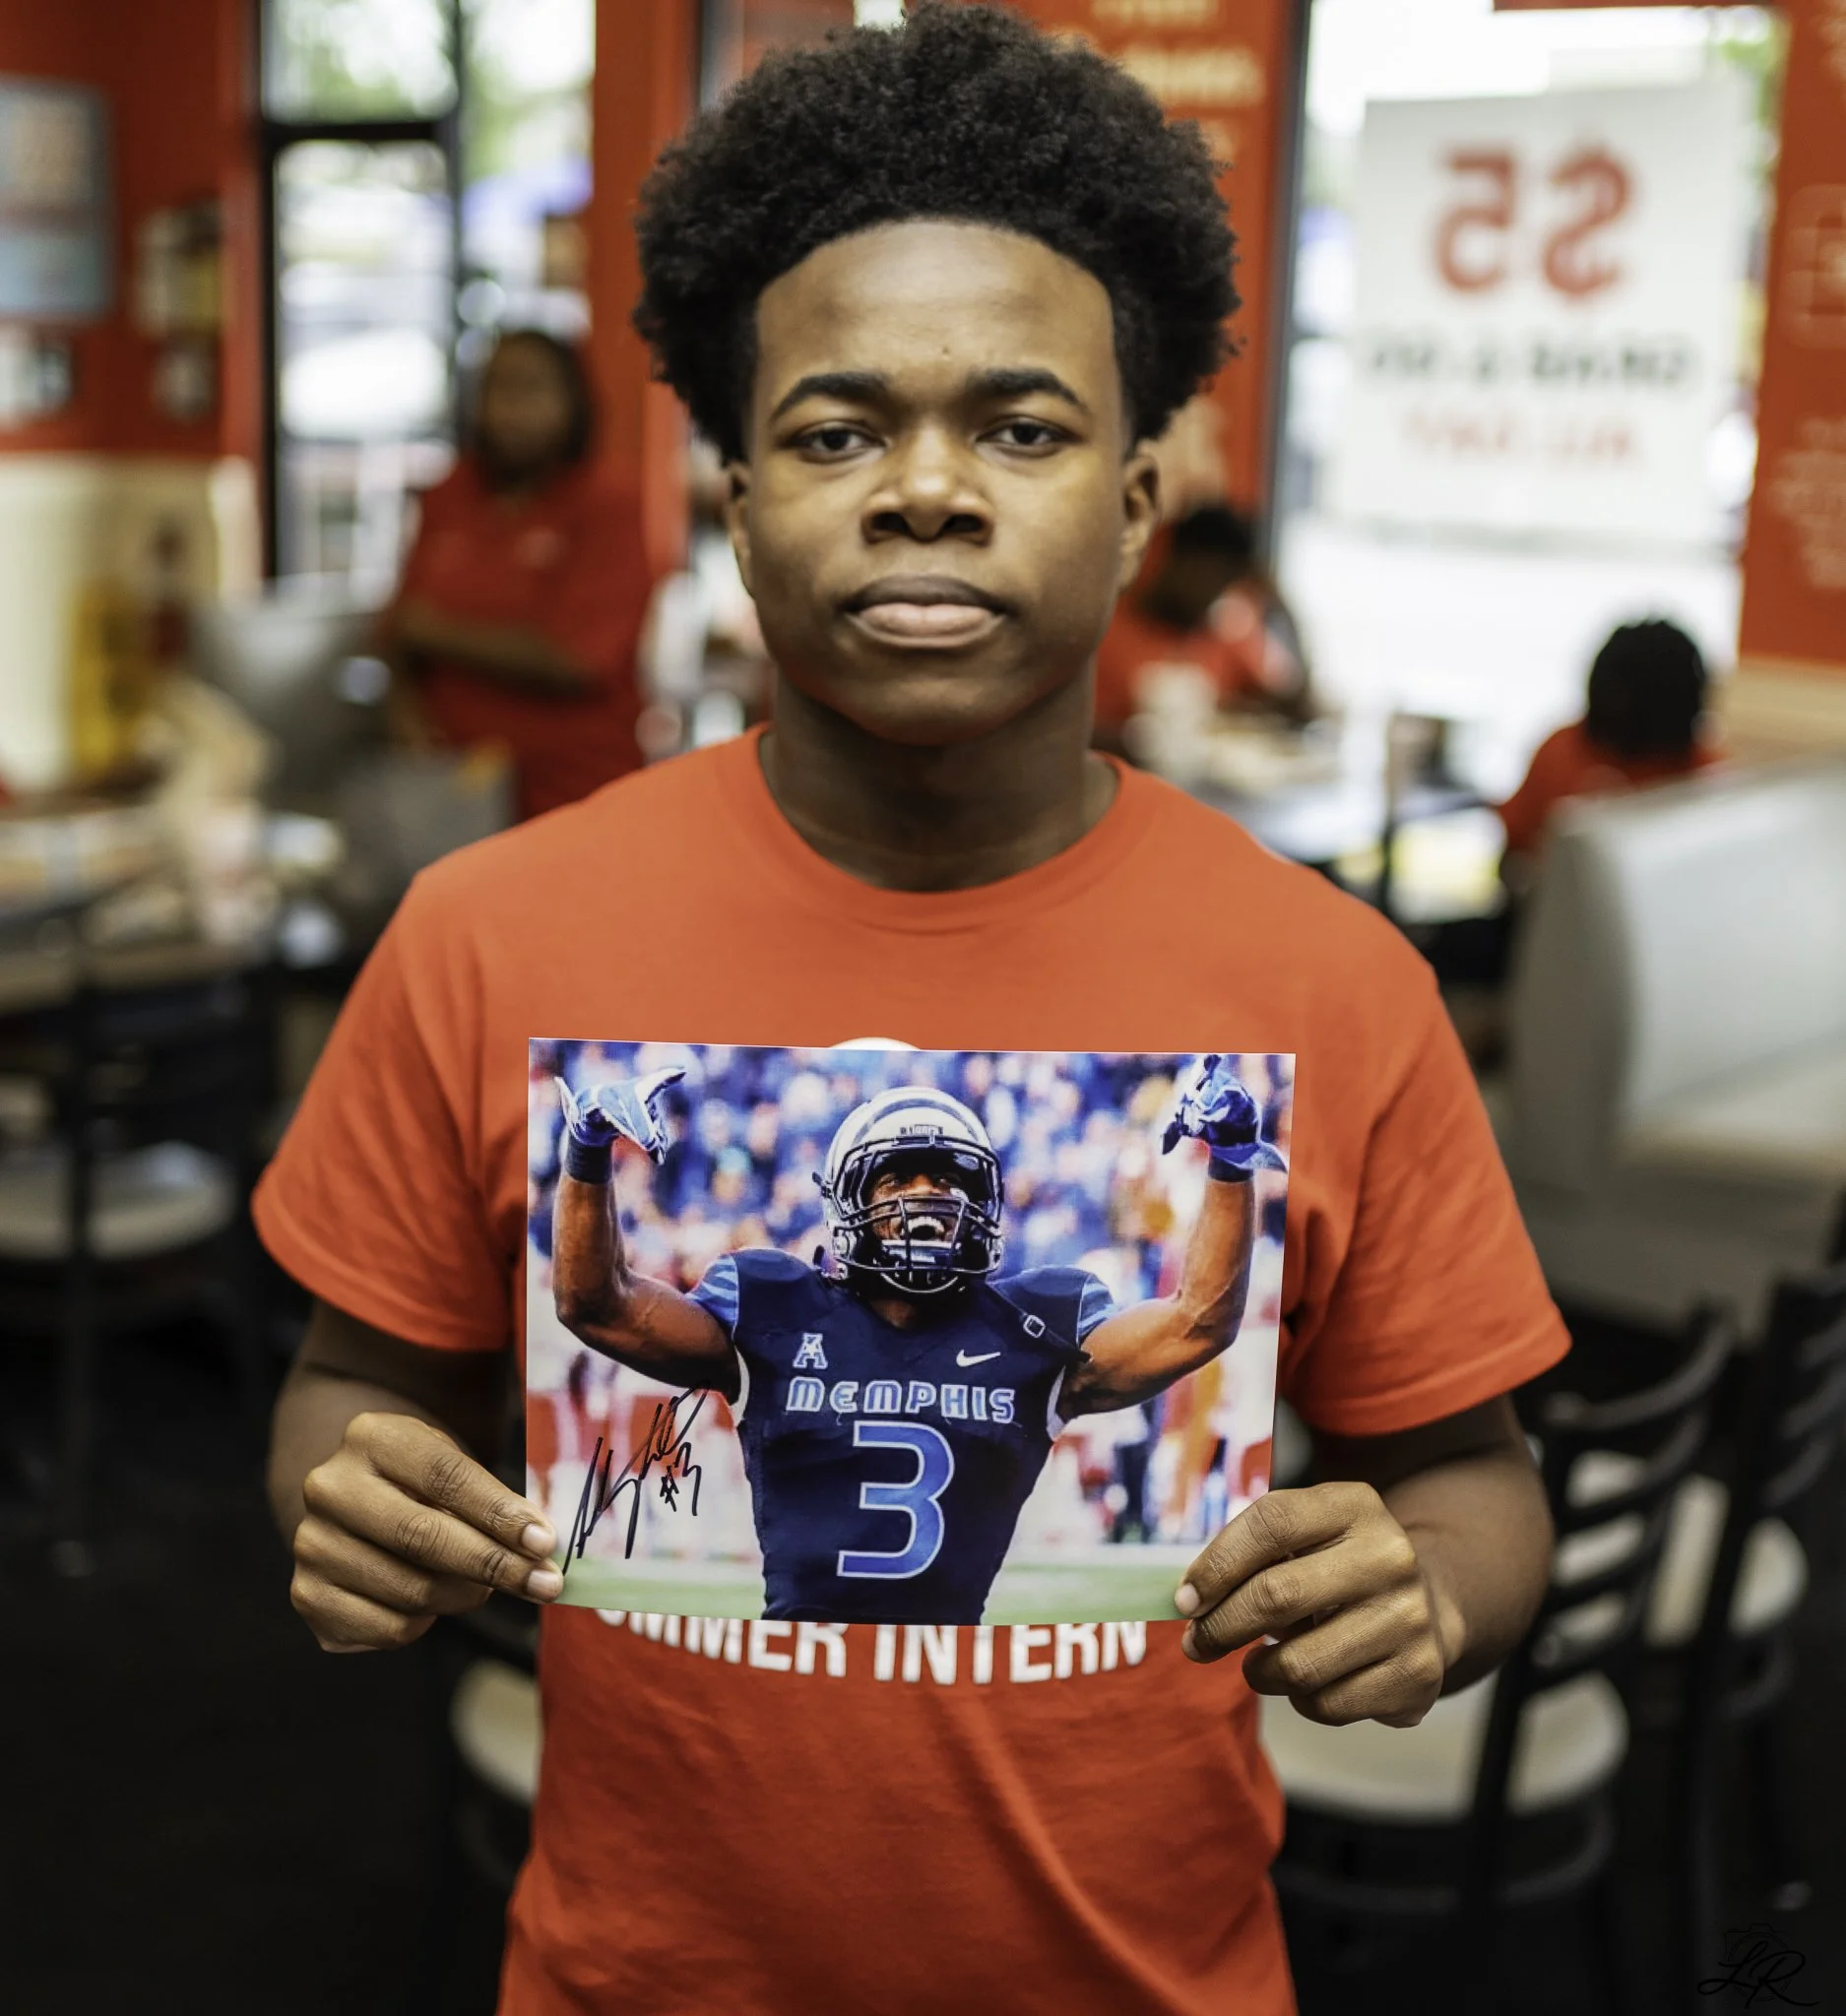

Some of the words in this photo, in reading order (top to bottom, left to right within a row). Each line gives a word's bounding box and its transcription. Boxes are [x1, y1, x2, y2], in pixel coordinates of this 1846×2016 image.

[786, 1376, 1015, 1423] MEMPHIS
[837, 1420, 955, 1580] 3
[873, 1621, 1147, 1685] INTERN
